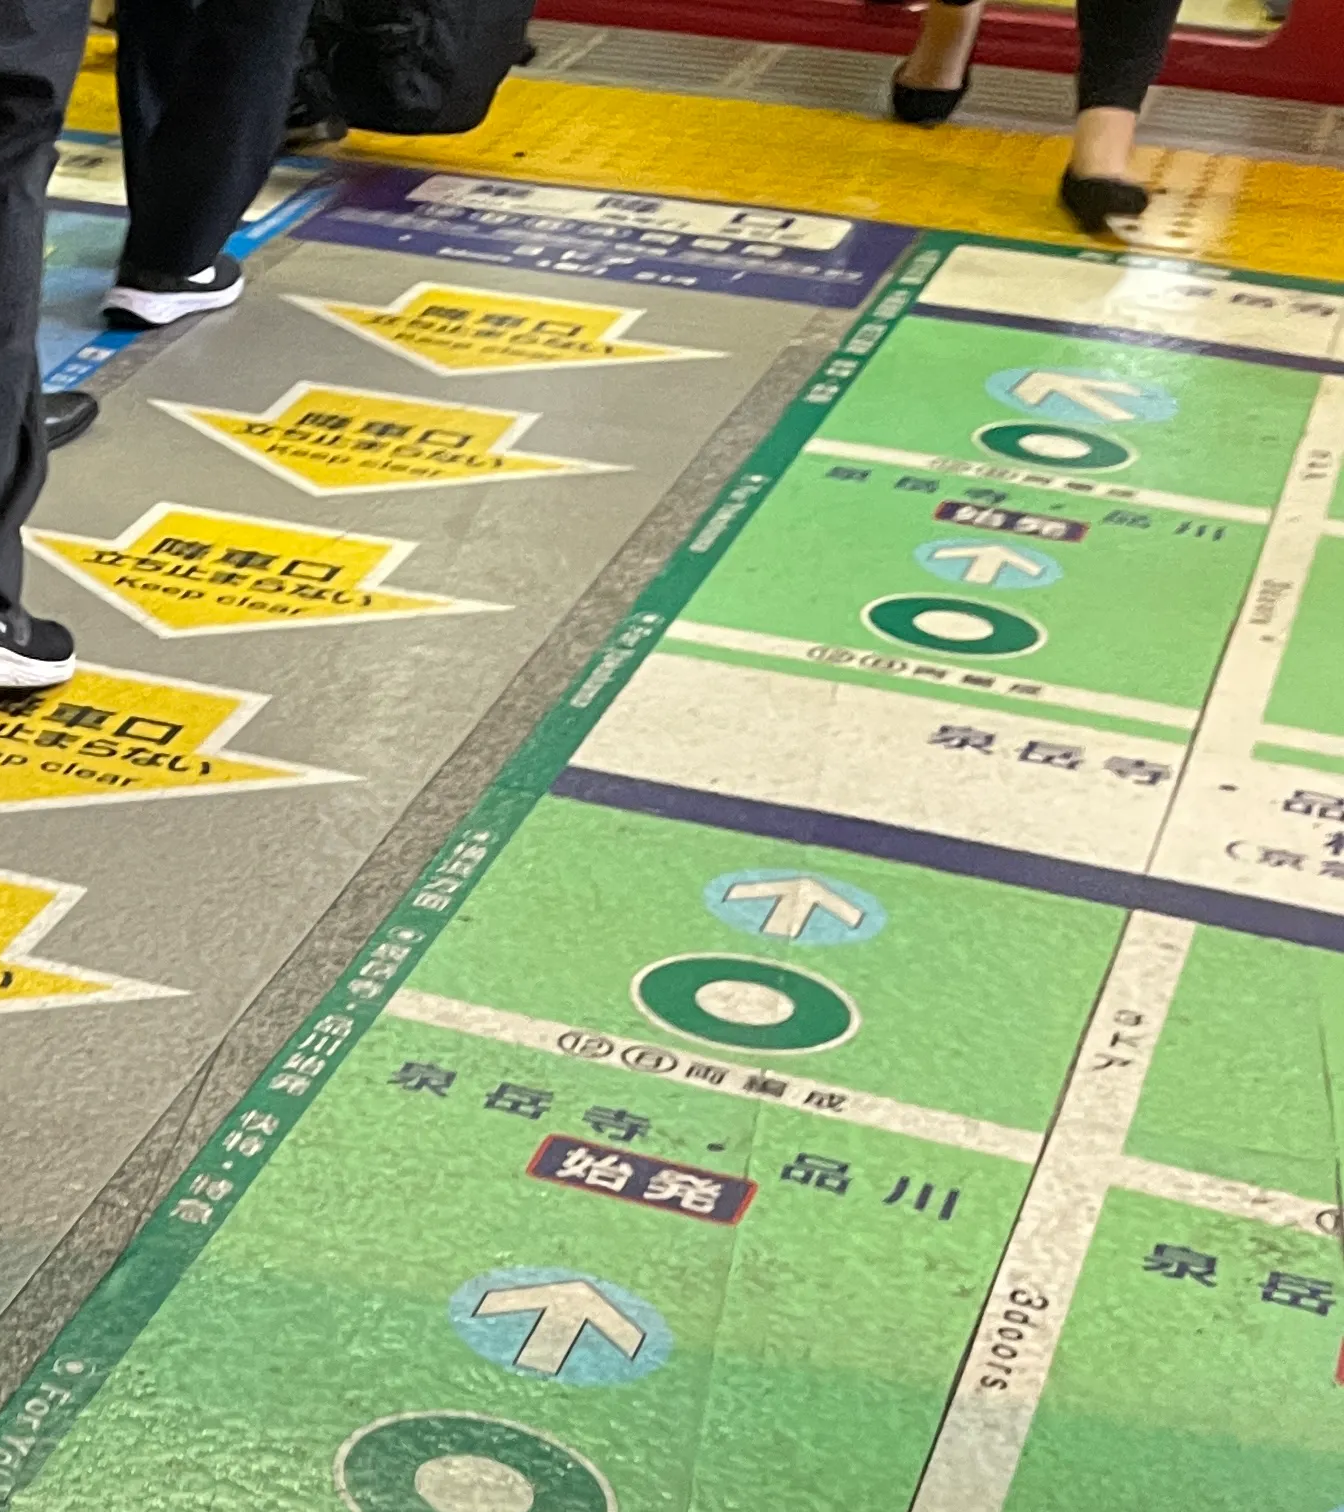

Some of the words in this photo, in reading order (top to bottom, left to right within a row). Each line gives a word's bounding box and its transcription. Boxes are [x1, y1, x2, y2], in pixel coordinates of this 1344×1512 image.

[83, 550, 372, 607] 立ち止まらない
[149, 537, 344, 582] 降車口
[113, 575, 206, 600] Keep
[216, 595, 313, 616] clear
[39, 759, 142, 788] clear
[555, 1145, 723, 1215] 始発
[980, 1288, 1050, 1392] 3doors
